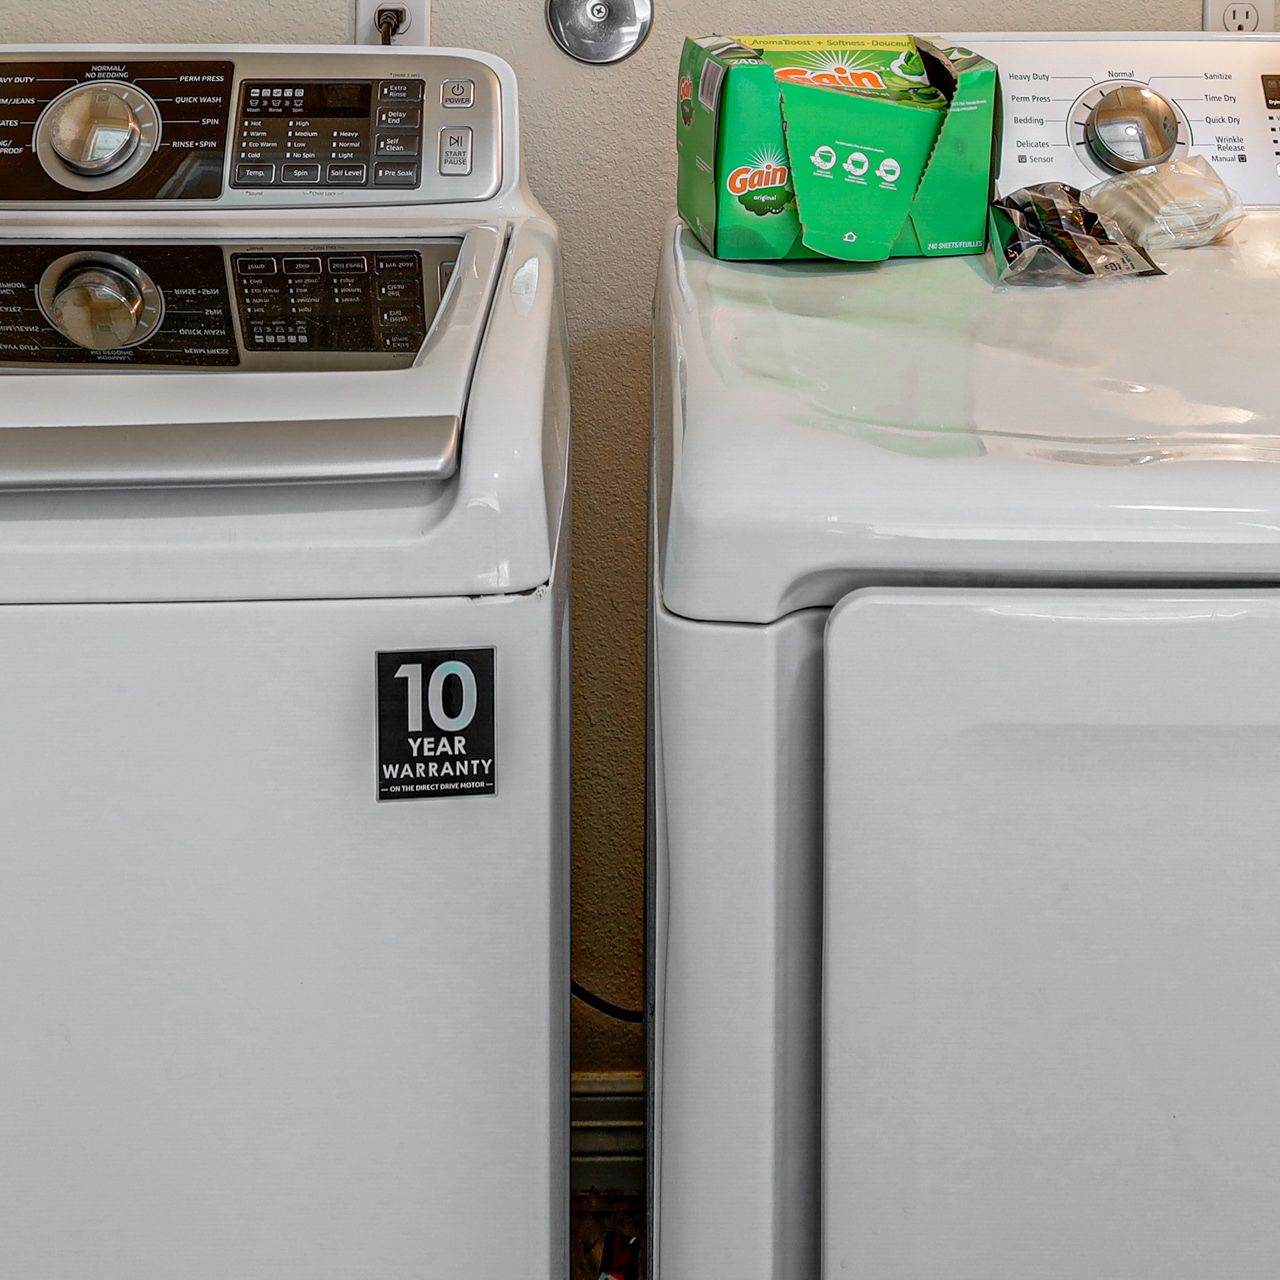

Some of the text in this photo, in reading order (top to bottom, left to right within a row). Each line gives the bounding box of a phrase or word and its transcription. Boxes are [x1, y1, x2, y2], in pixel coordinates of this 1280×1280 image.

[826, 39, 865, 47] Softness
[1009, 73, 1049, 81] Heavy Duty
[1223, 95, 1236, 103] Dry
[1013, 116, 1044, 125] Bedding
[1205, 116, 1240, 124] Quick Dry
[1016, 140, 1049, 148] Delicates
[1029, 155, 1054, 163] Sensor
[245, 169, 265, 177] Temp.
[293, 169, 308, 177] Spin
[728, 163, 787, 194] Gain
[394, 660, 478, 732] 10
[407, 736, 466, 757] YEAR
[382, 759, 492, 779] WARRANTY
[460, 781, 485, 789] MOTOR
